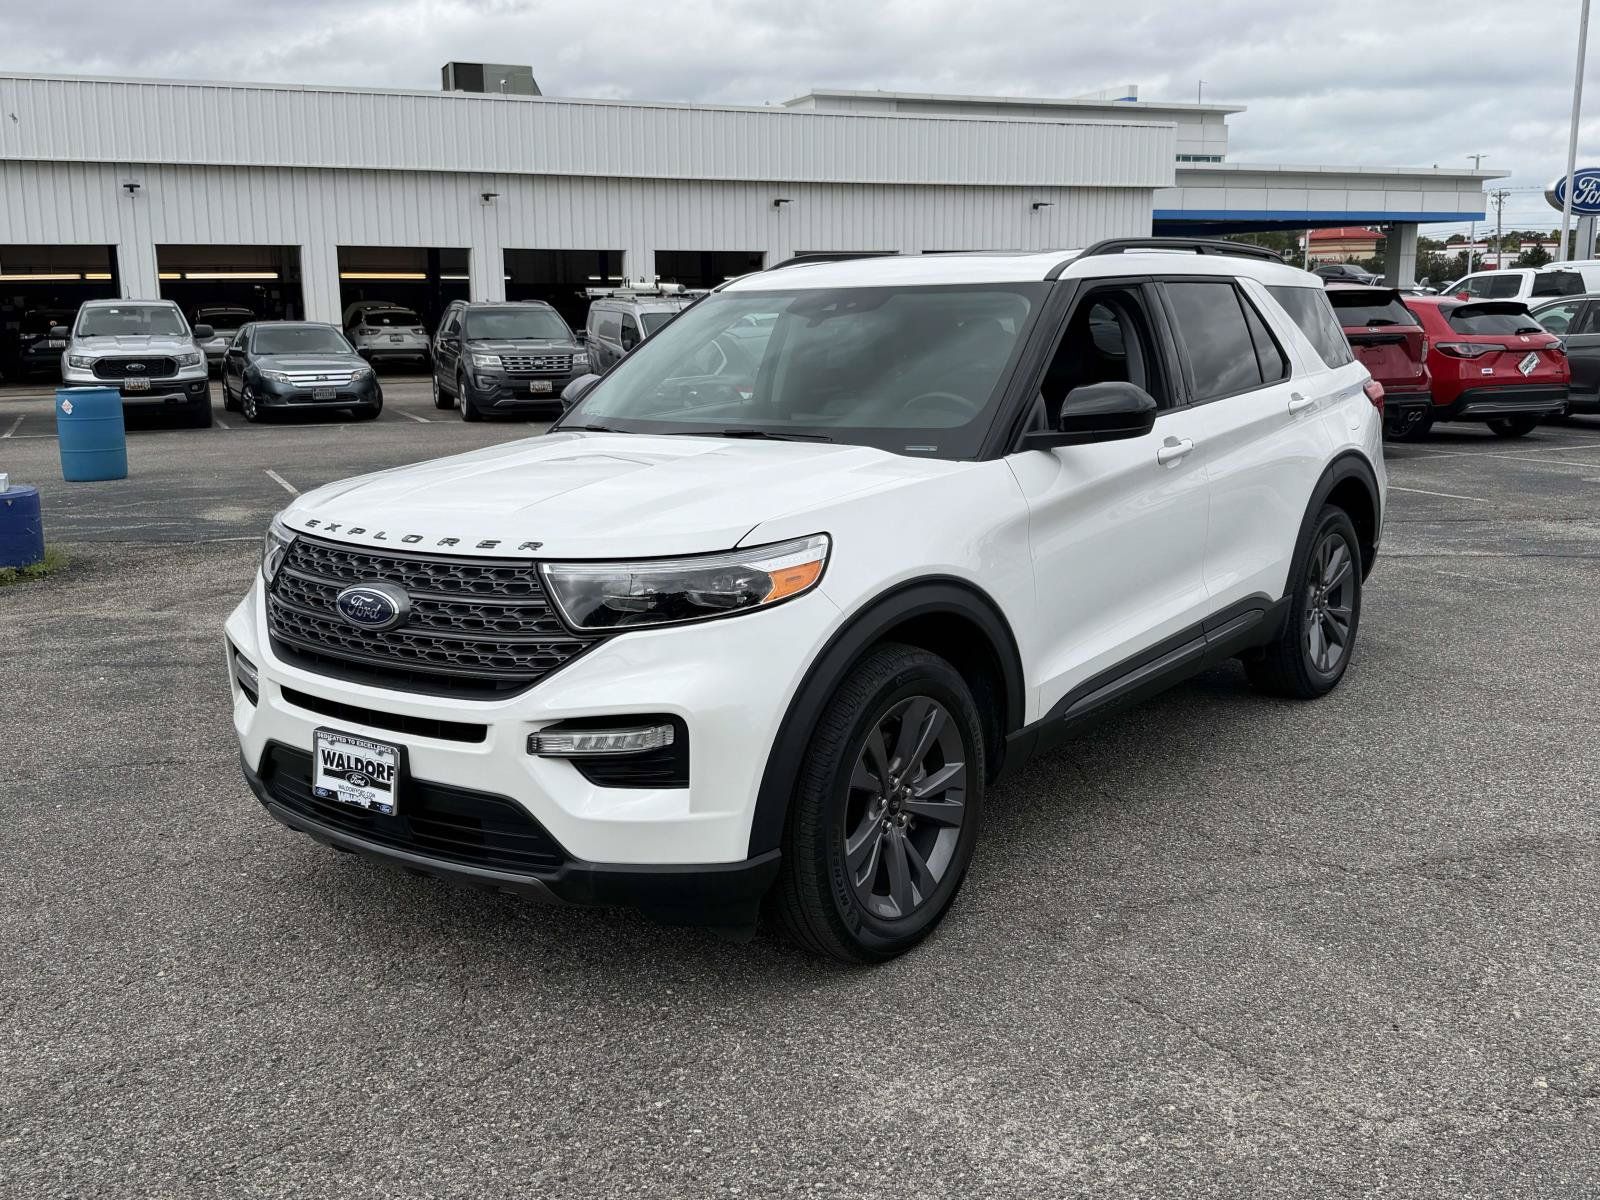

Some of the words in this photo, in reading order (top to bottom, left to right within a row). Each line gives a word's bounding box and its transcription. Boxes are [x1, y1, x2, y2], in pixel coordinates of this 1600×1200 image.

[304, 519, 545, 552] EXPLORER
[347, 595, 382, 620] Ford
[317, 732, 347, 744] DEDICATED
[348, 737, 356, 745] TO
[356, 740, 392, 753] EXCELLENCE
[321, 749, 395, 782] WALDORF
[350, 774, 366, 786] Ford
